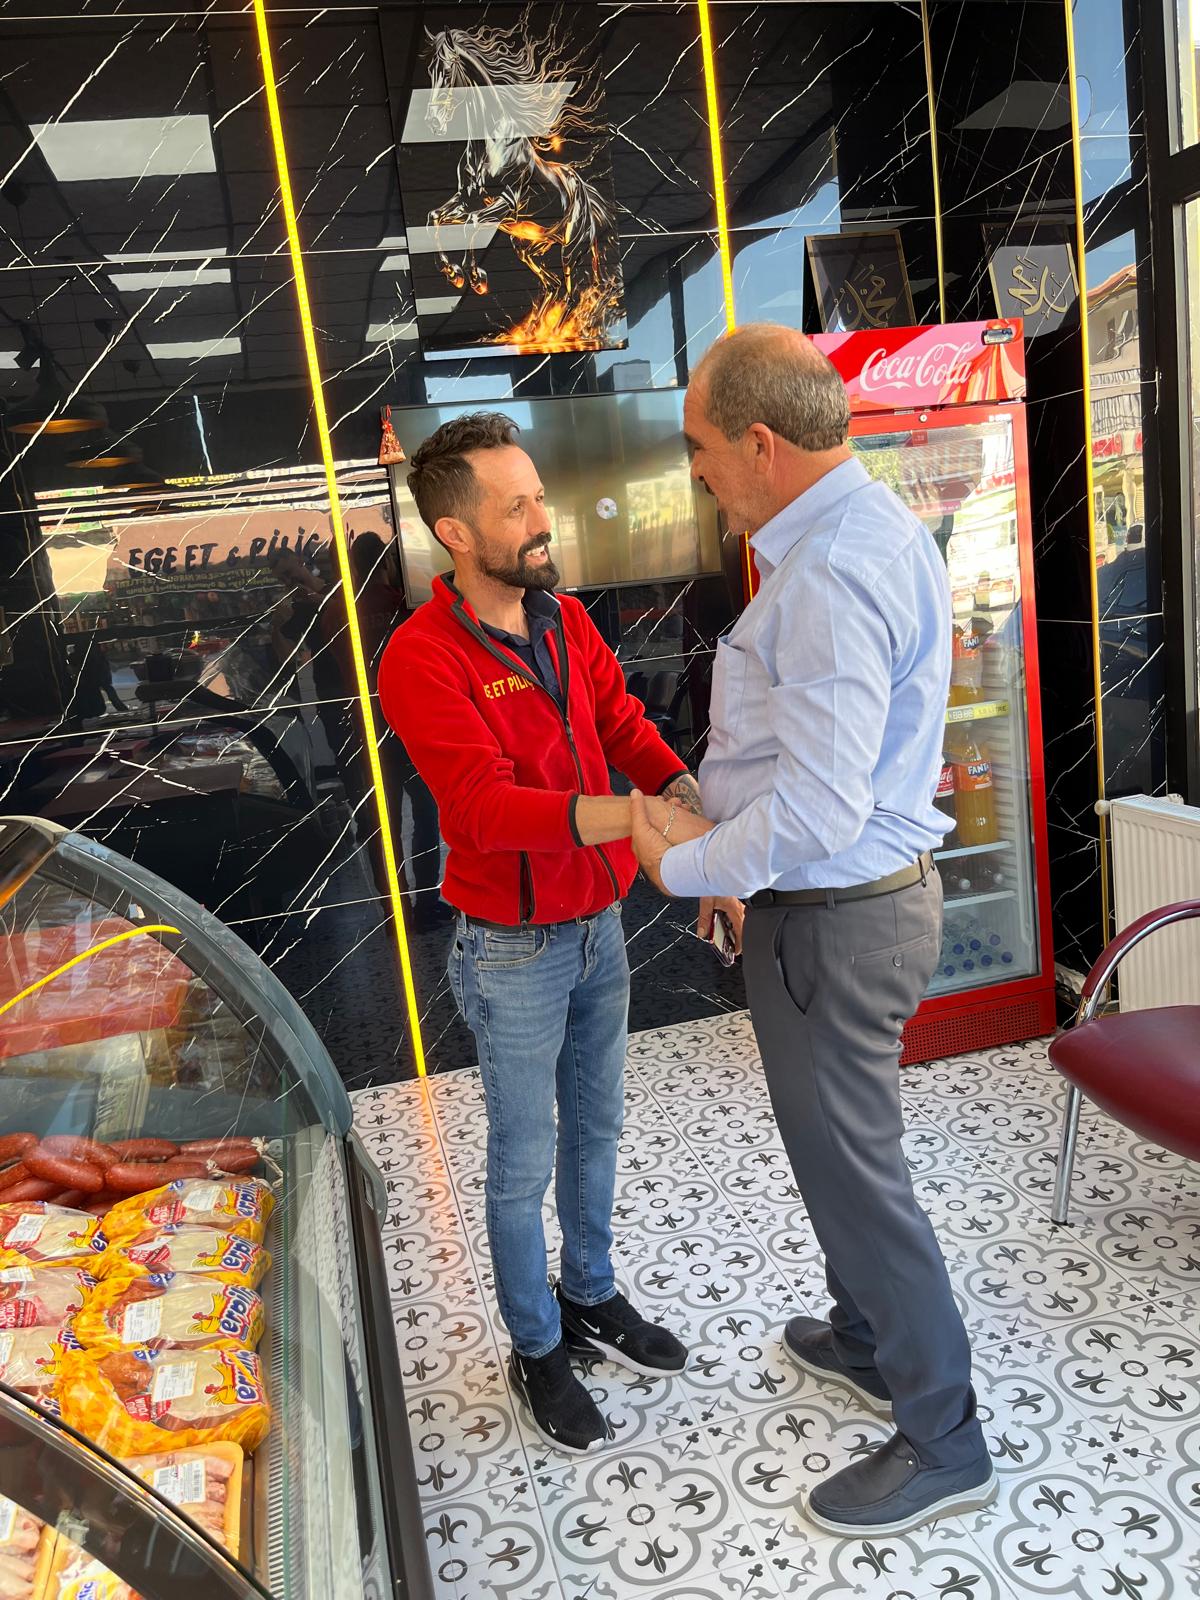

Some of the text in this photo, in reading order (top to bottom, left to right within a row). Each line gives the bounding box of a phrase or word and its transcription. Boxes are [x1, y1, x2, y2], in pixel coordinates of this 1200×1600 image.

[859, 341, 978, 392] Coca-Cola
[128, 547, 177, 579] EGE
[185, 543, 218, 573] ET
[492, 679, 505, 698] ET
